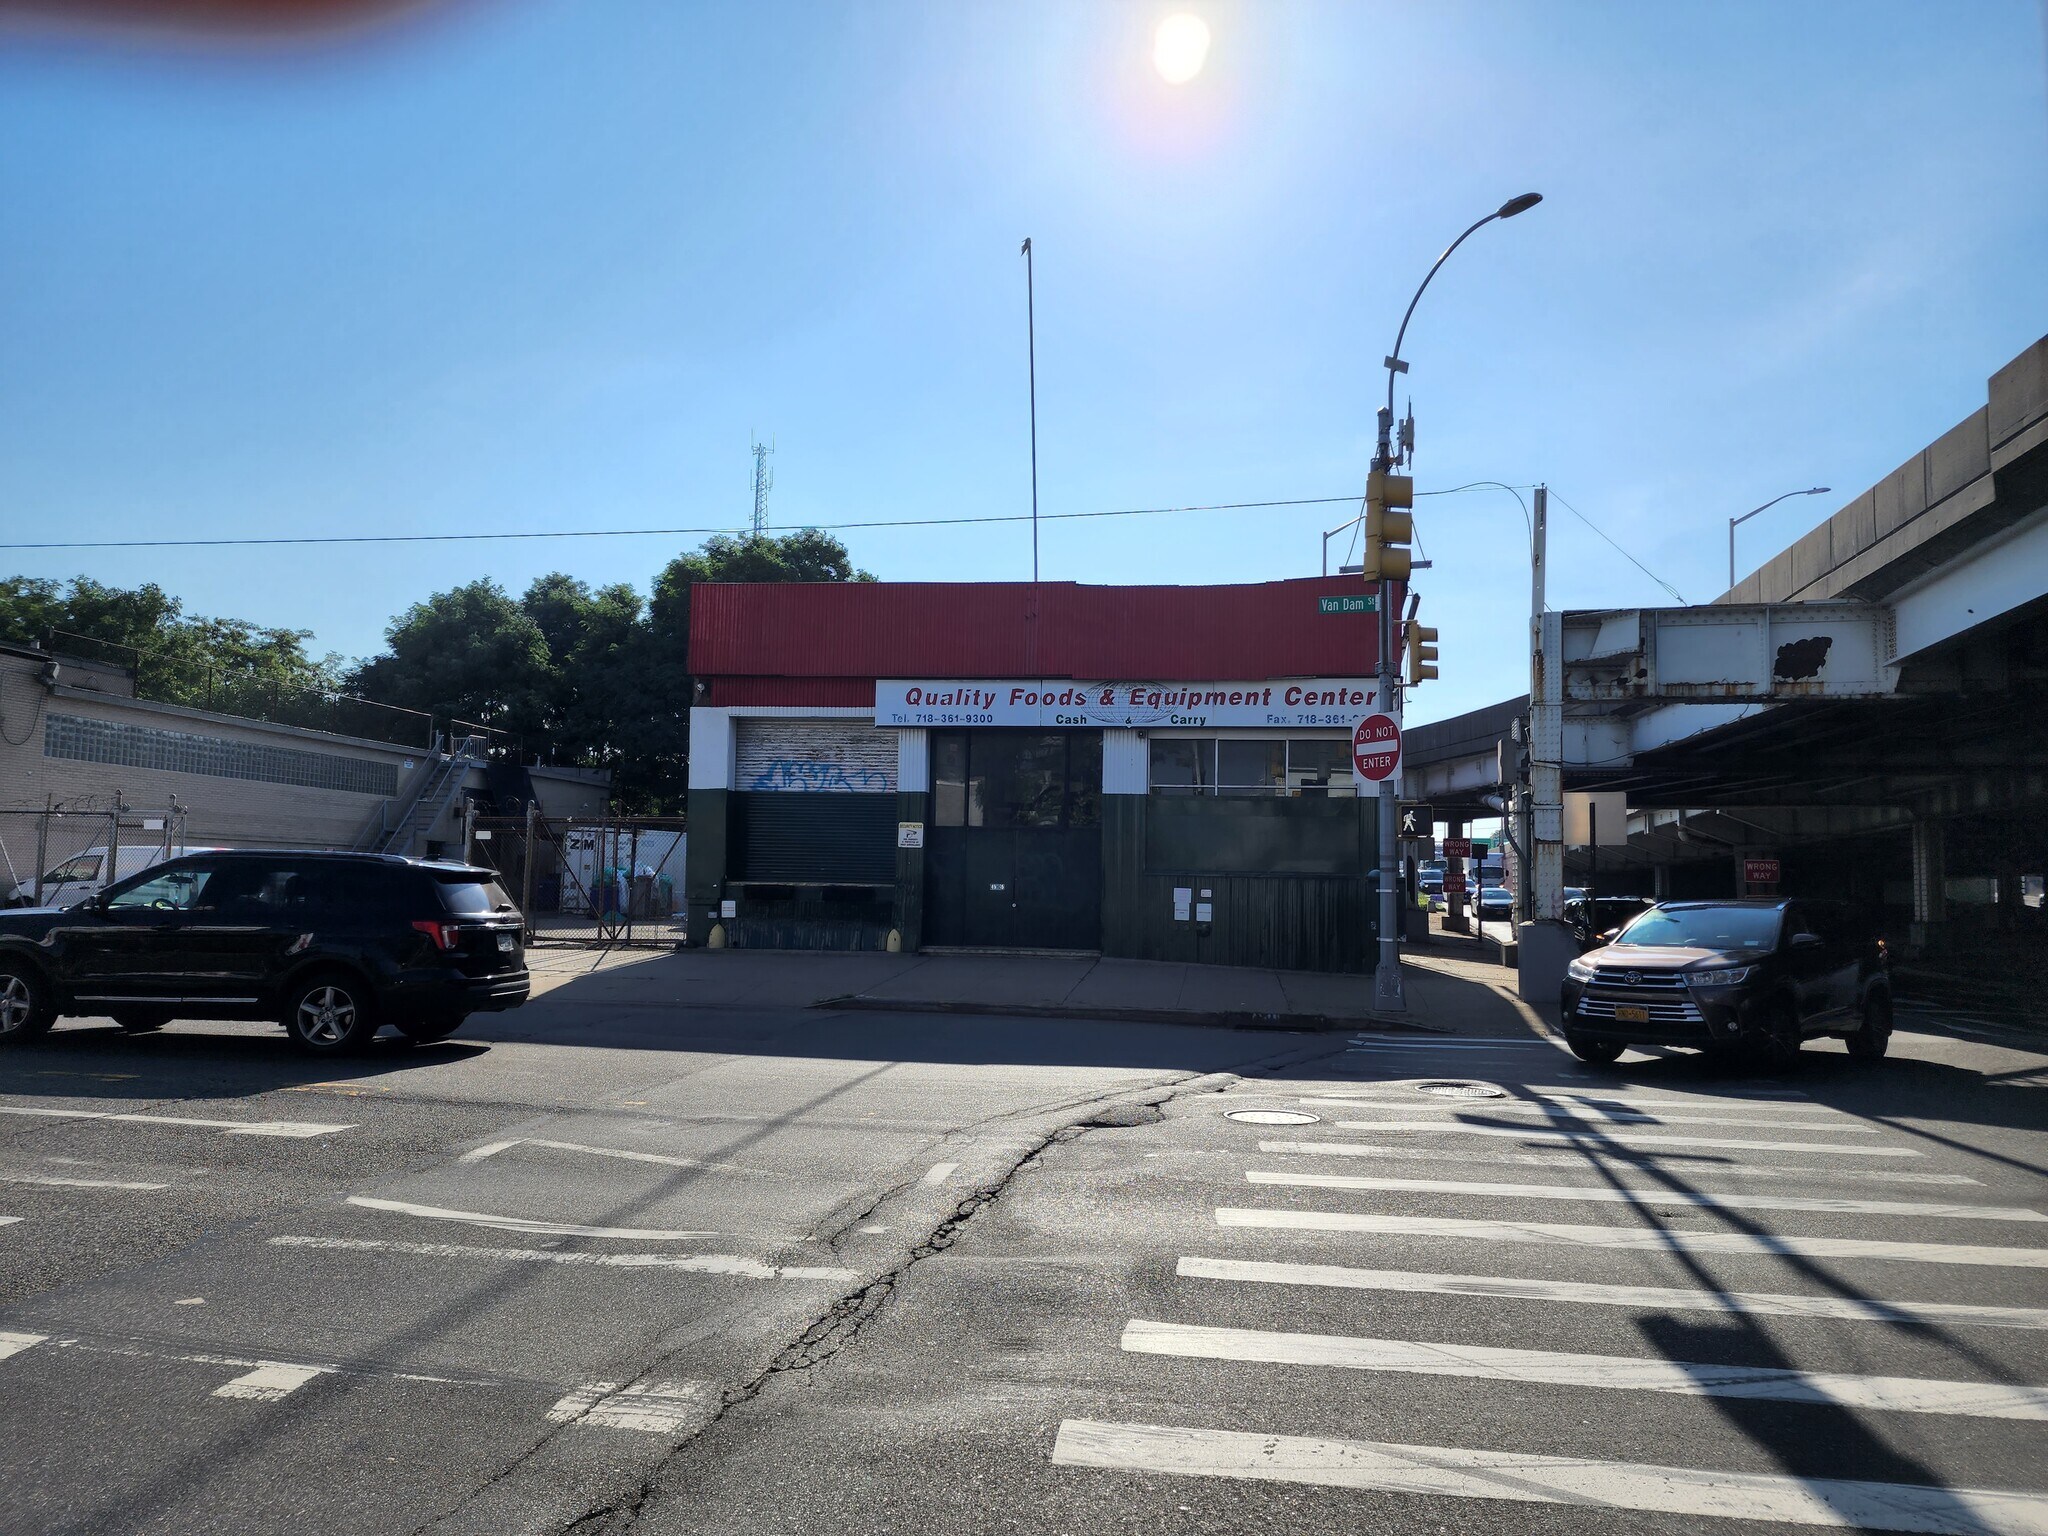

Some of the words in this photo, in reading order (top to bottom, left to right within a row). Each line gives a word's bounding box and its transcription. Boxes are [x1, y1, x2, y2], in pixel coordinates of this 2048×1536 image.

[1321, 599, 1339, 611] Van
[1343, 598, 1364, 610] Dam
[1367, 596, 1375, 606] St
[905, 687, 997, 710] Quality
[1009, 688, 1088, 706] Foods
[1099, 689, 1115, 706] &
[1129, 687, 1272, 709] Equipment
[1285, 687, 1377, 706] Center
[892, 714, 910, 723] Tel.
[916, 714, 993, 723] 718-361-9300
[1056, 714, 1088, 725] Cash
[1124, 716, 1132, 725] &
[1170, 714, 1207, 727] Carry
[1267, 714, 1291, 724] Fax.
[1298, 714, 1366, 724] 718-361-
[1359, 729, 1371, 740] DO
[1376, 725, 1394, 738] NOT
[1363, 756, 1391, 769] ENTER
